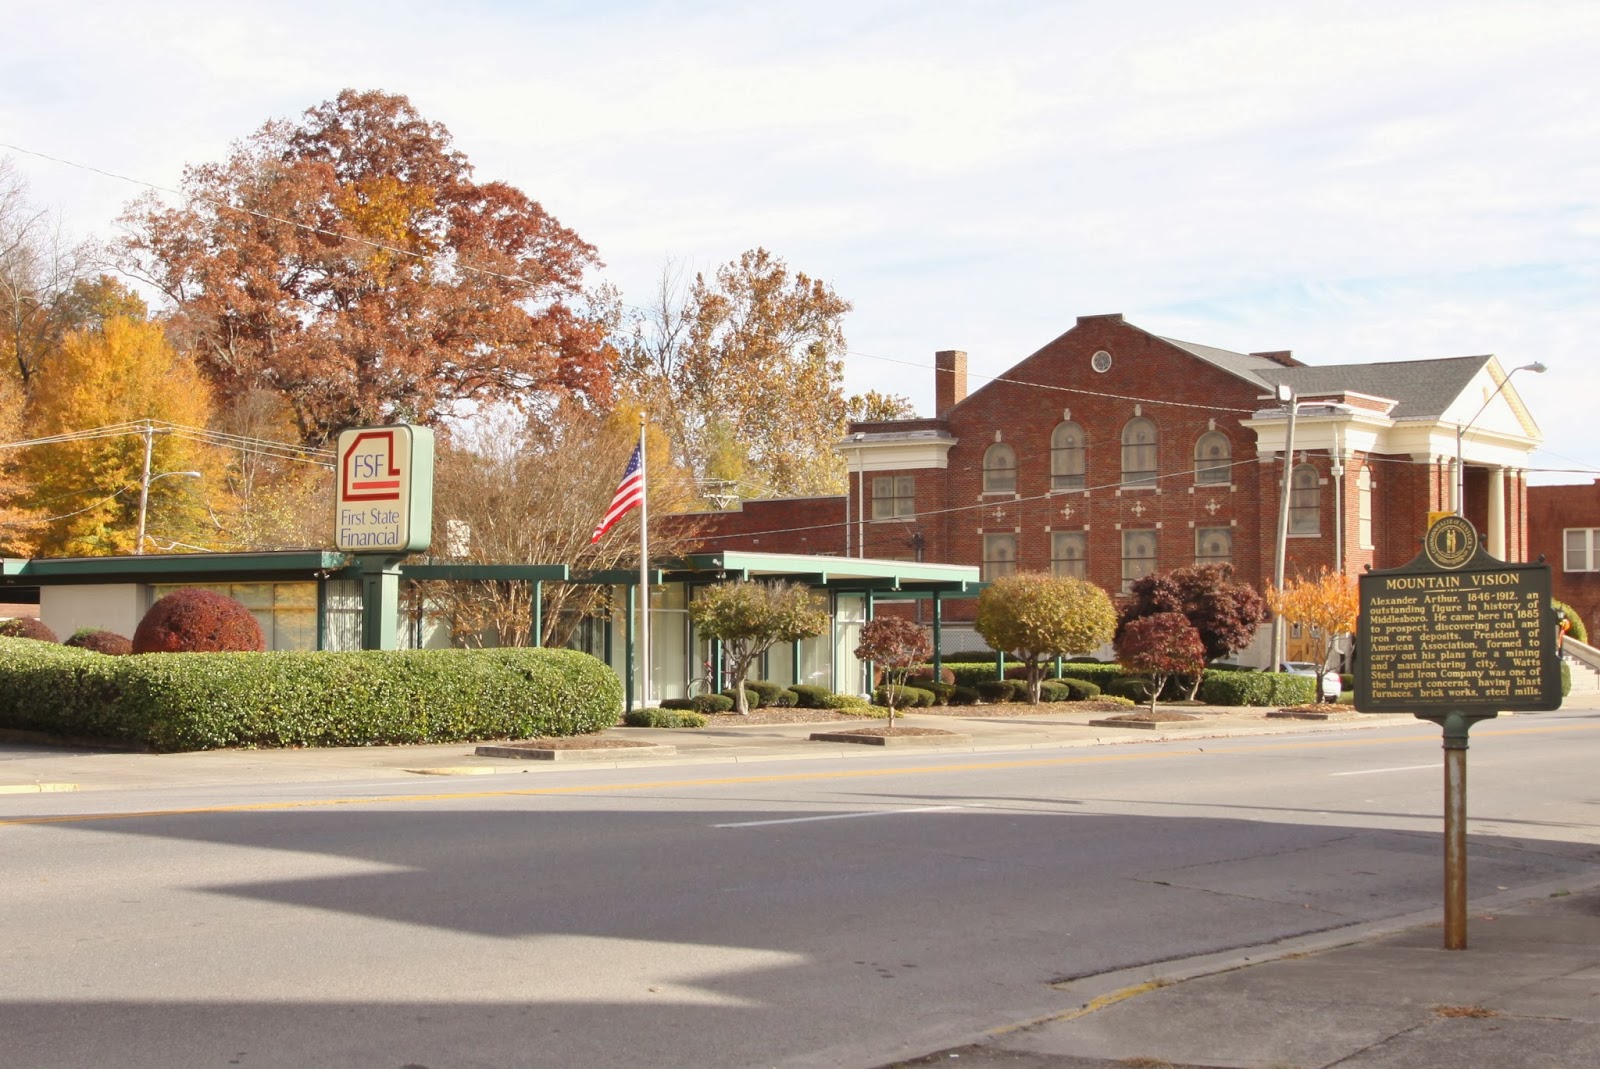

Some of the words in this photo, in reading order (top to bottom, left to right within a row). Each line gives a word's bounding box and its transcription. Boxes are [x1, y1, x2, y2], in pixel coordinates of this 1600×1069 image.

[354, 454, 384, 478] FSF
[341, 509, 366, 526] First
[370, 507, 399, 524] State
[340, 525, 399, 546] Financial
[1386, 576, 1460, 590] MOUNTAIN
[1471, 573, 1519, 585] VISION
[1370, 596, 1417, 605] Alexander
[1370, 606, 1425, 614] outstanding
[1432, 604, 1462, 613] figure
[1468, 603, 1477, 611] in
[1484, 602, 1521, 611] history
[1528, 600, 1539, 608] of
[1370, 615, 1428, 624] Middlesboro.
[1478, 612, 1500, 620] here
[1504, 611, 1513, 619] in
[1517, 609, 1539, 618] 1885
[1435, 622, 1490, 631] discovering
[1495, 620, 1515, 628] coal
[1521, 620, 1539, 628] and
[1420, 633, 1461, 642] deposits.
[1474, 631, 1519, 639] President
[1528, 629, 1539, 637] of
[1487, 639, 1521, 648] formed
[1529, 639, 1540, 647] to
[1402, 652, 1417, 660] out
[1422, 651, 1435, 659] his
[1441, 651, 1465, 661] plans
[1472, 650, 1487, 658] for
[1506, 649, 1540, 658] mining
[1371, 662, 1387, 670] and
[1397, 661, 1466, 669] manufacturing
[1476, 660, 1498, 669] city.
[1371, 671, 1394, 679] Steel
[1398, 670, 1414, 678] and
[1418, 670, 1437, 678] Iron
[1441, 670, 1484, 679] Company
[1529, 667, 1541, 675] of
[1391, 681, 1422, 690] largest
[1478, 679, 1510, 687] having
[1517, 677, 1541, 685] blast
[1421, 689, 1444, 697] brick
[1486, 688, 1509, 696] steel
[1515, 687, 1541, 695] mills.
